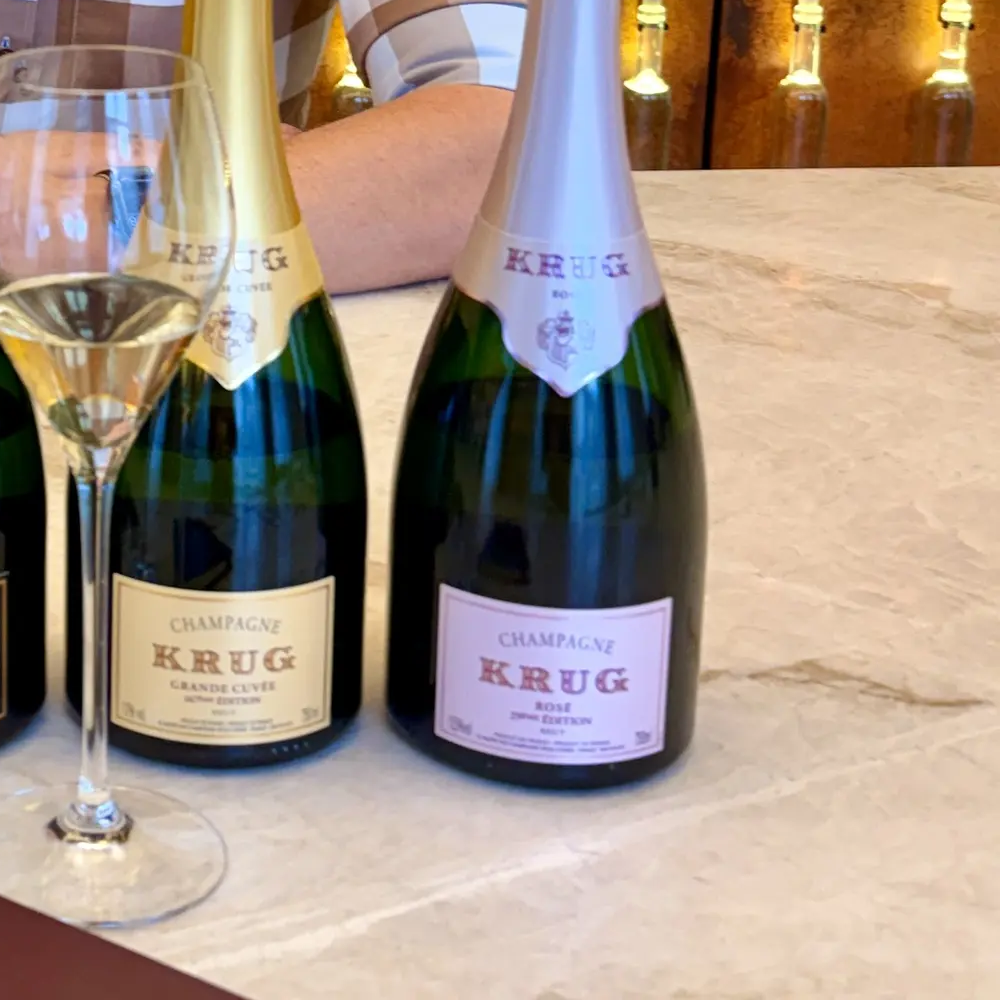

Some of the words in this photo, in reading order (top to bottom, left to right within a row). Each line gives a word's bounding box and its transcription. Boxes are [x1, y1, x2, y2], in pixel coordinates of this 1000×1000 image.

[503, 246, 631, 279] KRUG
[169, 613, 282, 636] CHAMPAGNE
[151, 642, 297, 675] KRUG
[498, 631, 616, 657] CHAMPAGNE
[169, 679, 229, 694] GRANDE
[478, 655, 630, 696] KRUG
